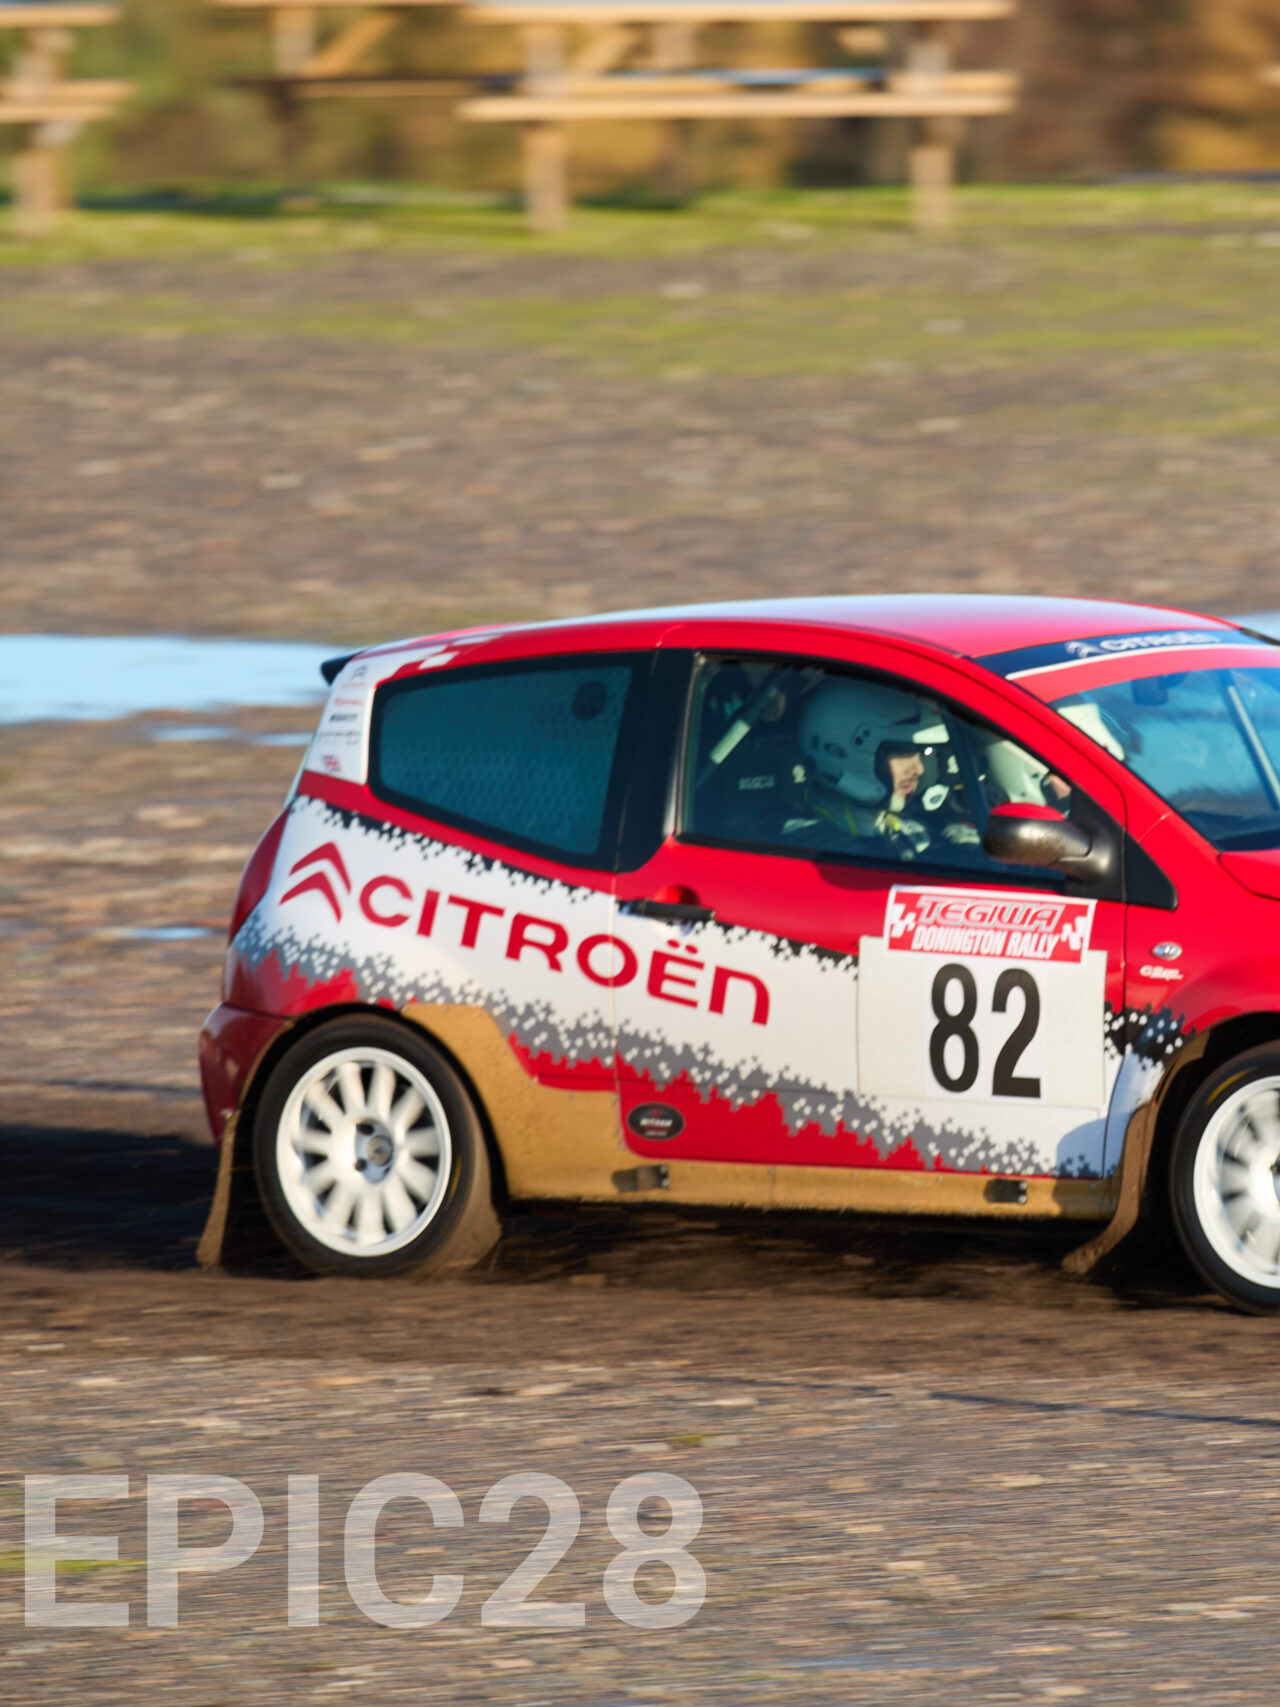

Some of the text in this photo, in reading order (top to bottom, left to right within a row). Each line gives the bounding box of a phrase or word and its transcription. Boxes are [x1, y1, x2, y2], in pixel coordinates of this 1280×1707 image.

[358, 875, 770, 1026] CITROËN
[911, 924, 1061, 960] DONINGTON RALLY
[916, 895, 1066, 932] TEGIWA
[929, 963, 1041, 1098] 82
